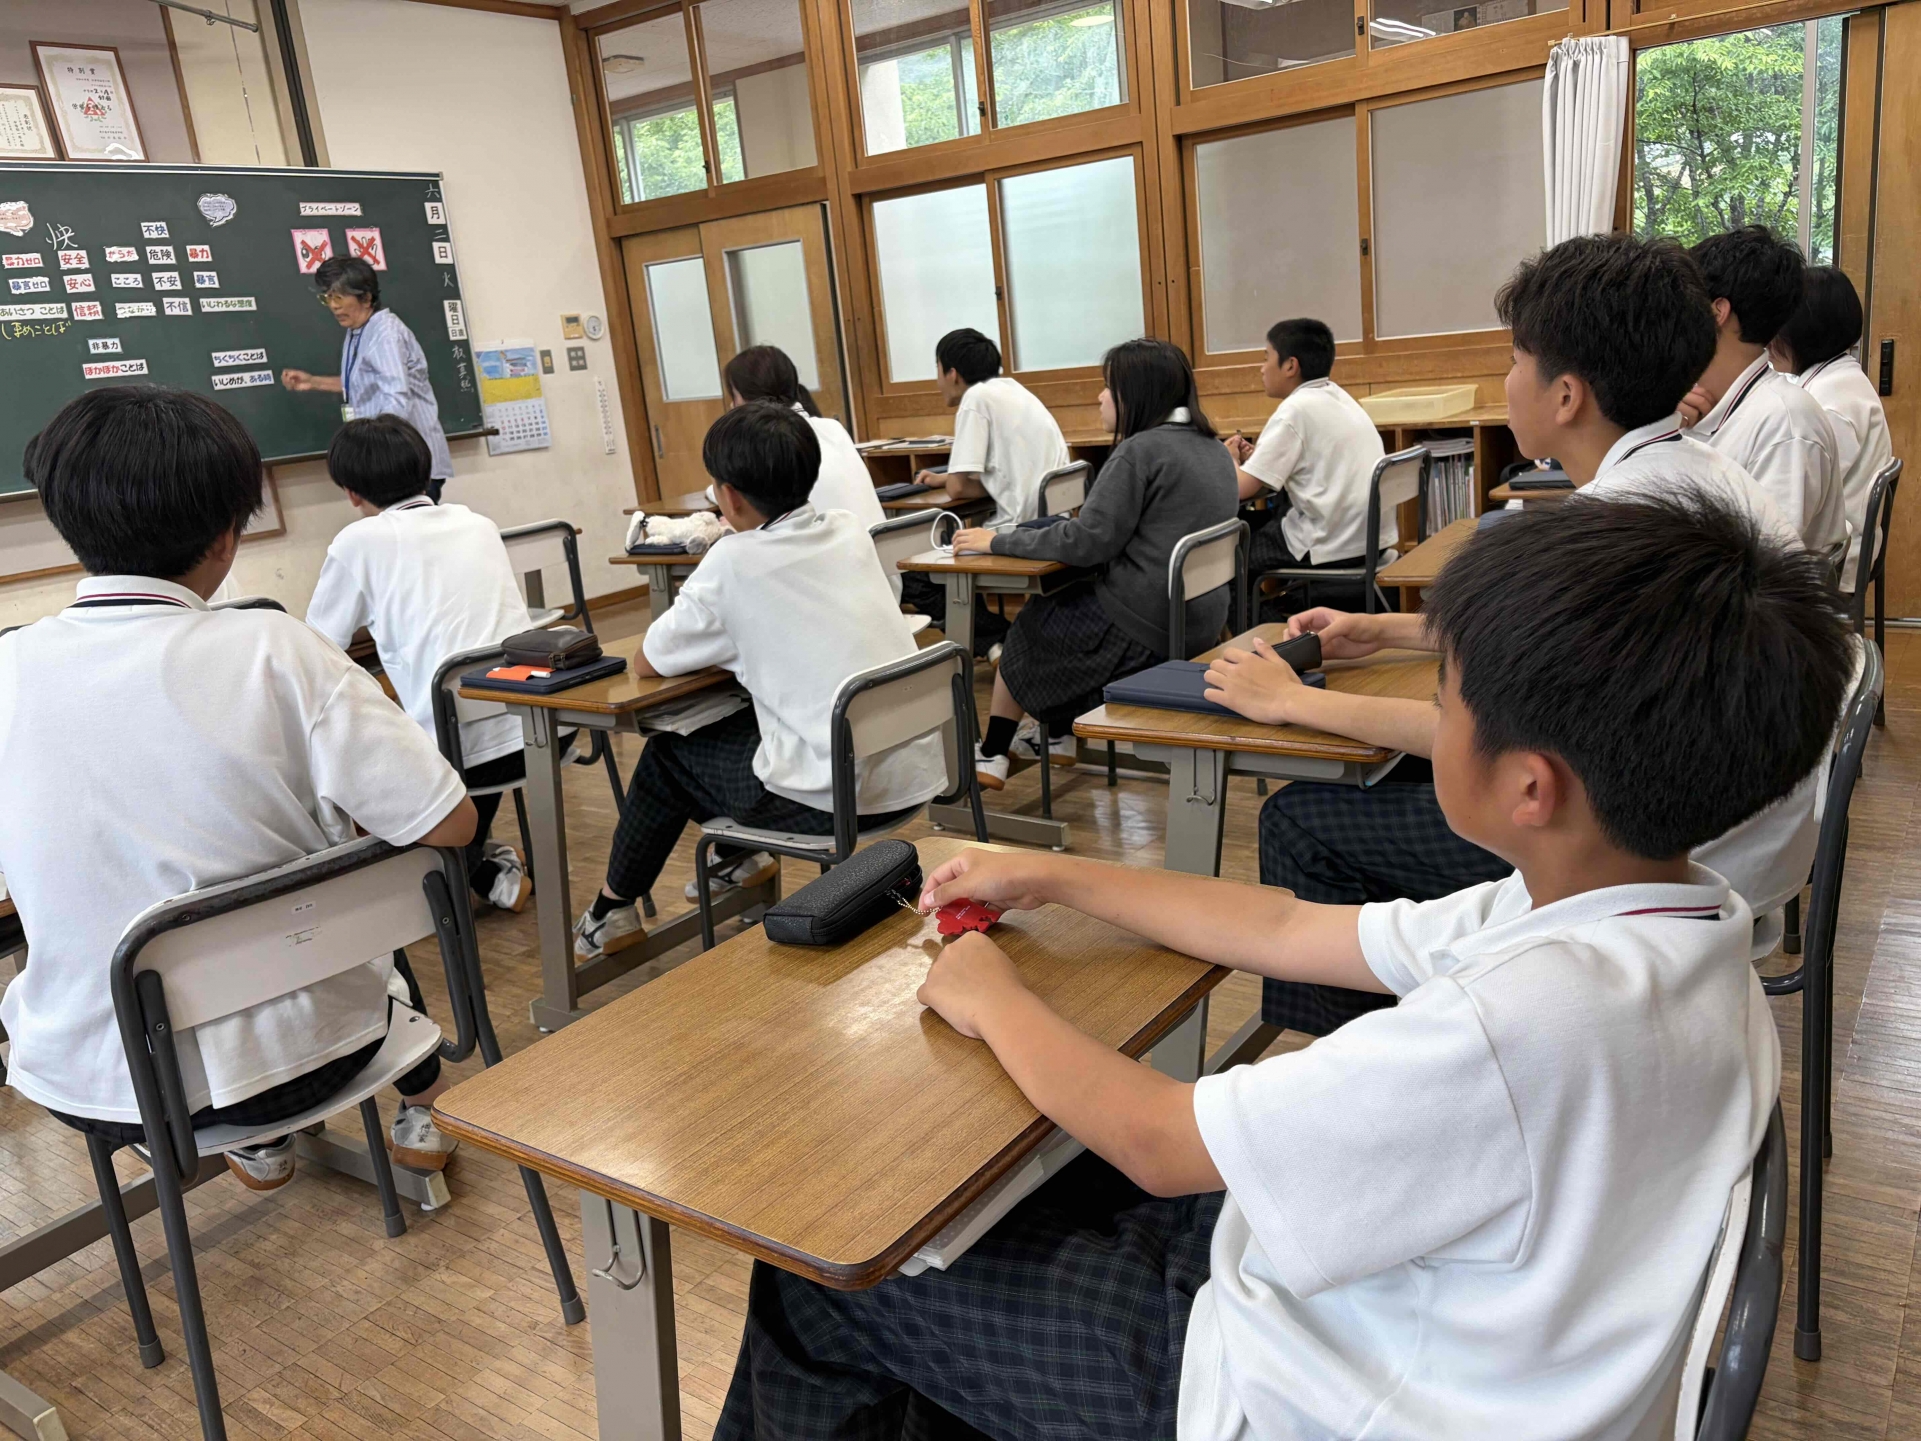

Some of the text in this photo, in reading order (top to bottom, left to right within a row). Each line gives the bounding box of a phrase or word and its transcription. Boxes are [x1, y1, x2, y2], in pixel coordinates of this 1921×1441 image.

[46, 222, 78, 250] 快
[143, 224, 167, 236] 不快
[61, 253, 86, 266] 安全
[148, 249, 174, 261] 危険
[189, 248, 210, 259] 暴力
[5, 256, 41, 267] 暴力ゼロ
[11, 280, 48, 291] 暴言ゼロ
[66, 277, 92, 290] 安心
[113, 277, 141, 286] こころ
[154, 275, 179, 288] 不安
[196, 275, 217, 286] 暴言
[0, 307, 35, 317] あいさつ
[74, 304, 101, 317] 信頼
[165, 301, 189, 313] 不信
[91, 341, 119, 351] 非暴力
